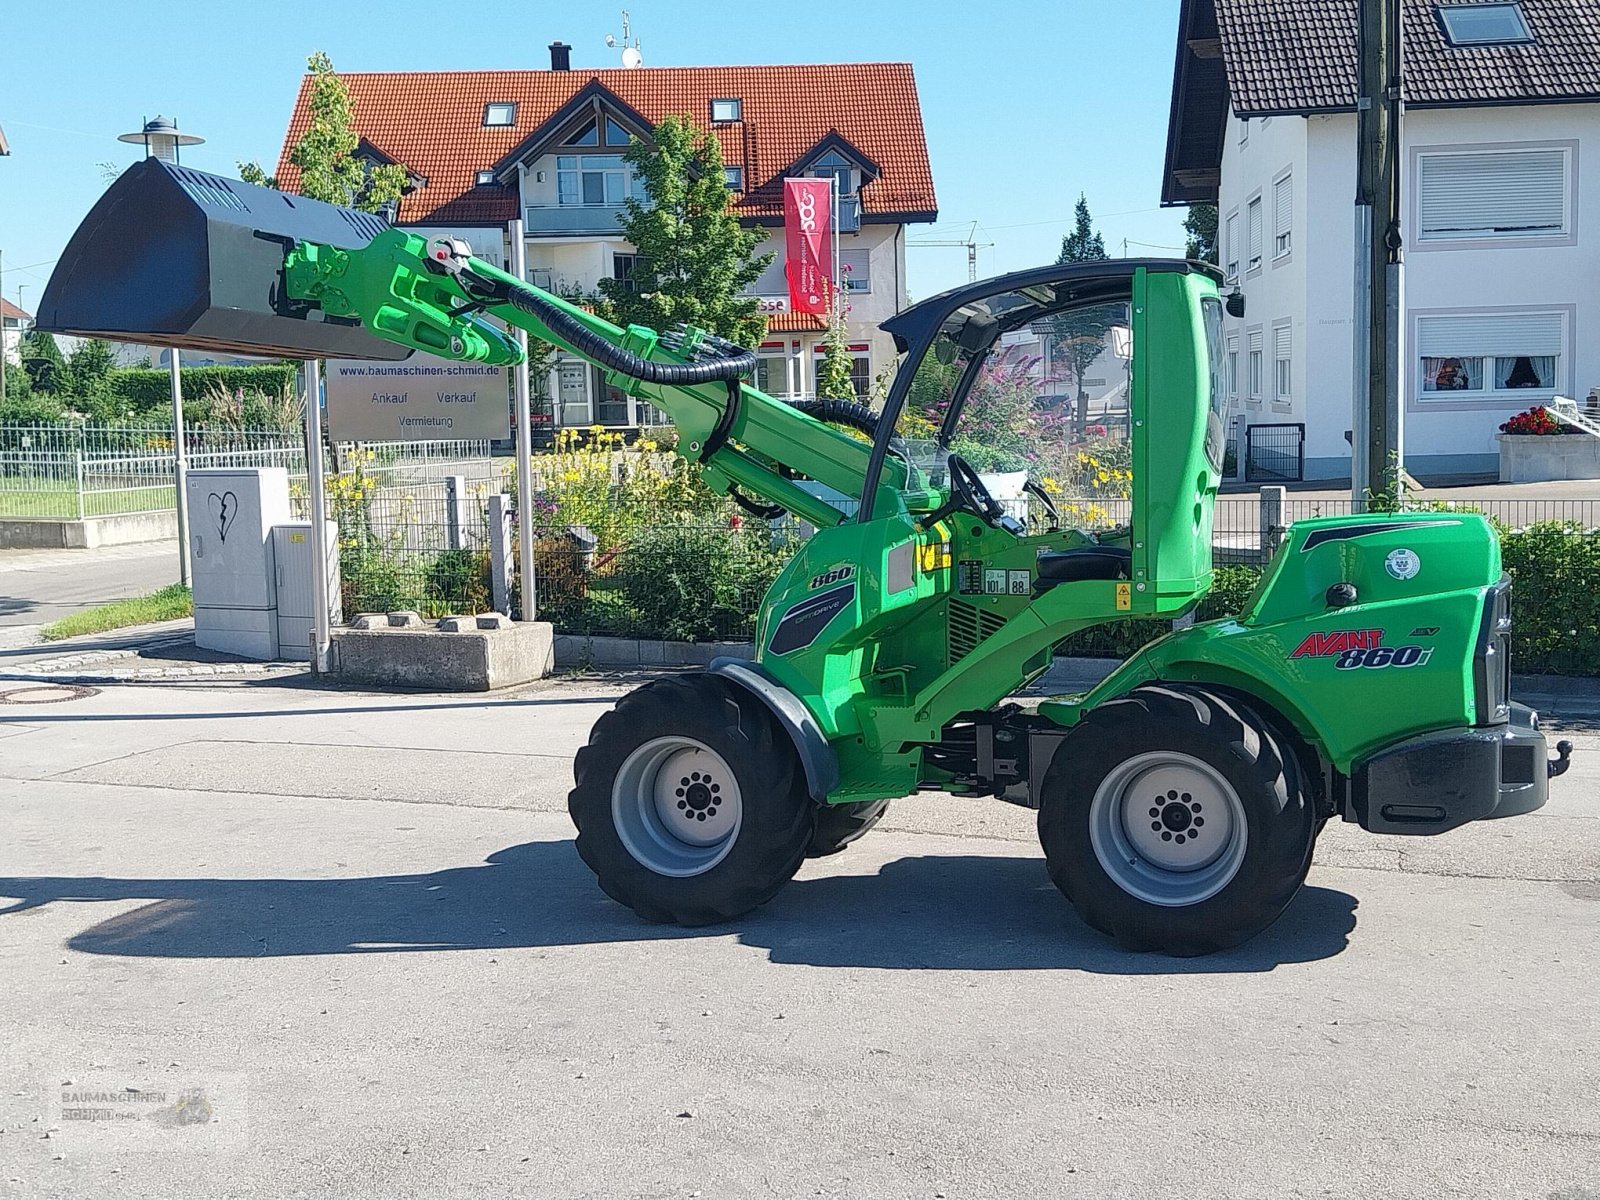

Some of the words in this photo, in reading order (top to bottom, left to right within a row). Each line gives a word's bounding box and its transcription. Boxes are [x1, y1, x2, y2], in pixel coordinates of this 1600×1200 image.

[339, 366, 499, 376] www.baumaschinen-schmid.de
[371, 392, 409, 404] Ankauf
[436, 392, 477, 403] Verkauf
[398, 416, 453, 428] Vermietung
[986, 580, 999, 593] 101
[1012, 580, 1024, 594] 88
[1290, 631, 1384, 658] AVANT
[1334, 646, 1434, 671] 860i
